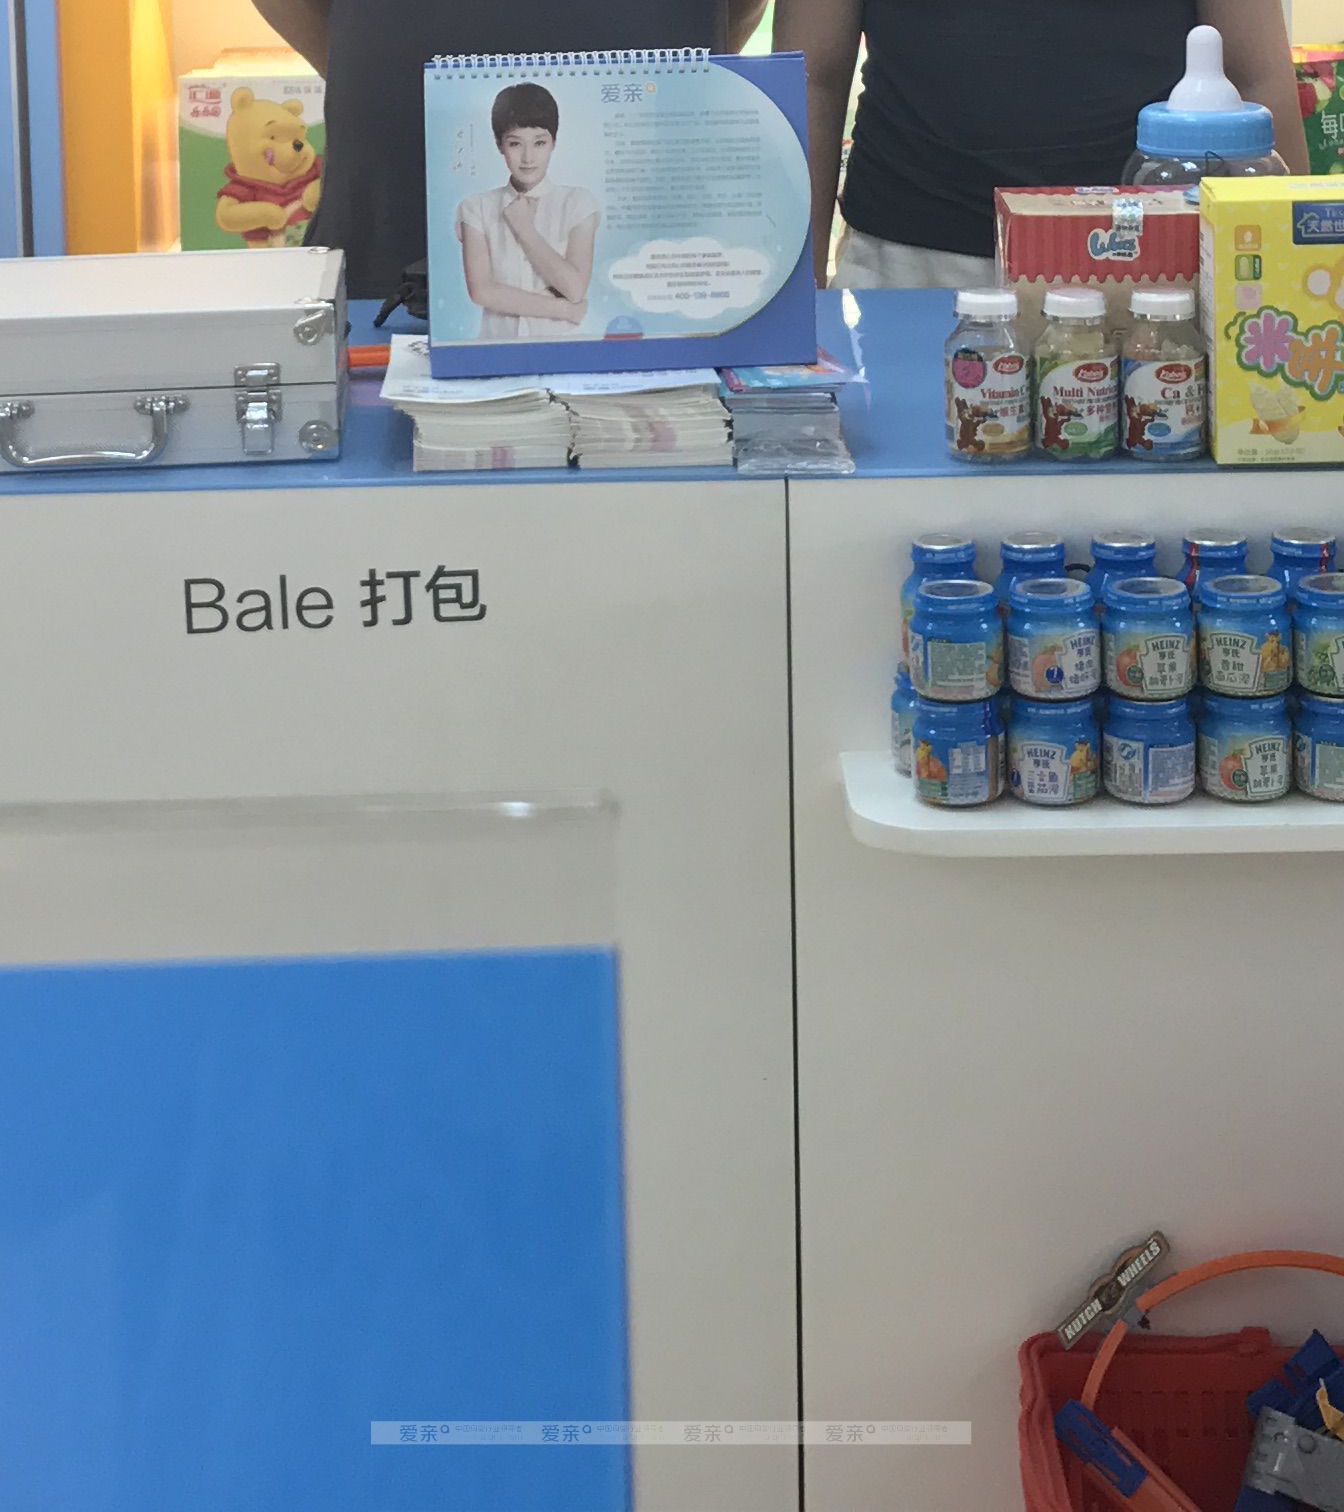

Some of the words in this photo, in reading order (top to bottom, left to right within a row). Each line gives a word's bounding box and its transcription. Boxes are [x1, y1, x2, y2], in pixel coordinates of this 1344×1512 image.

[601, 83, 643, 104] 爱亲
[1160, 388, 1181, 400] Ca
[183, 574, 334, 635] Bale
[360, 565, 487, 629] 打包
[1117, 1240, 1161, 1287] WHEELS
